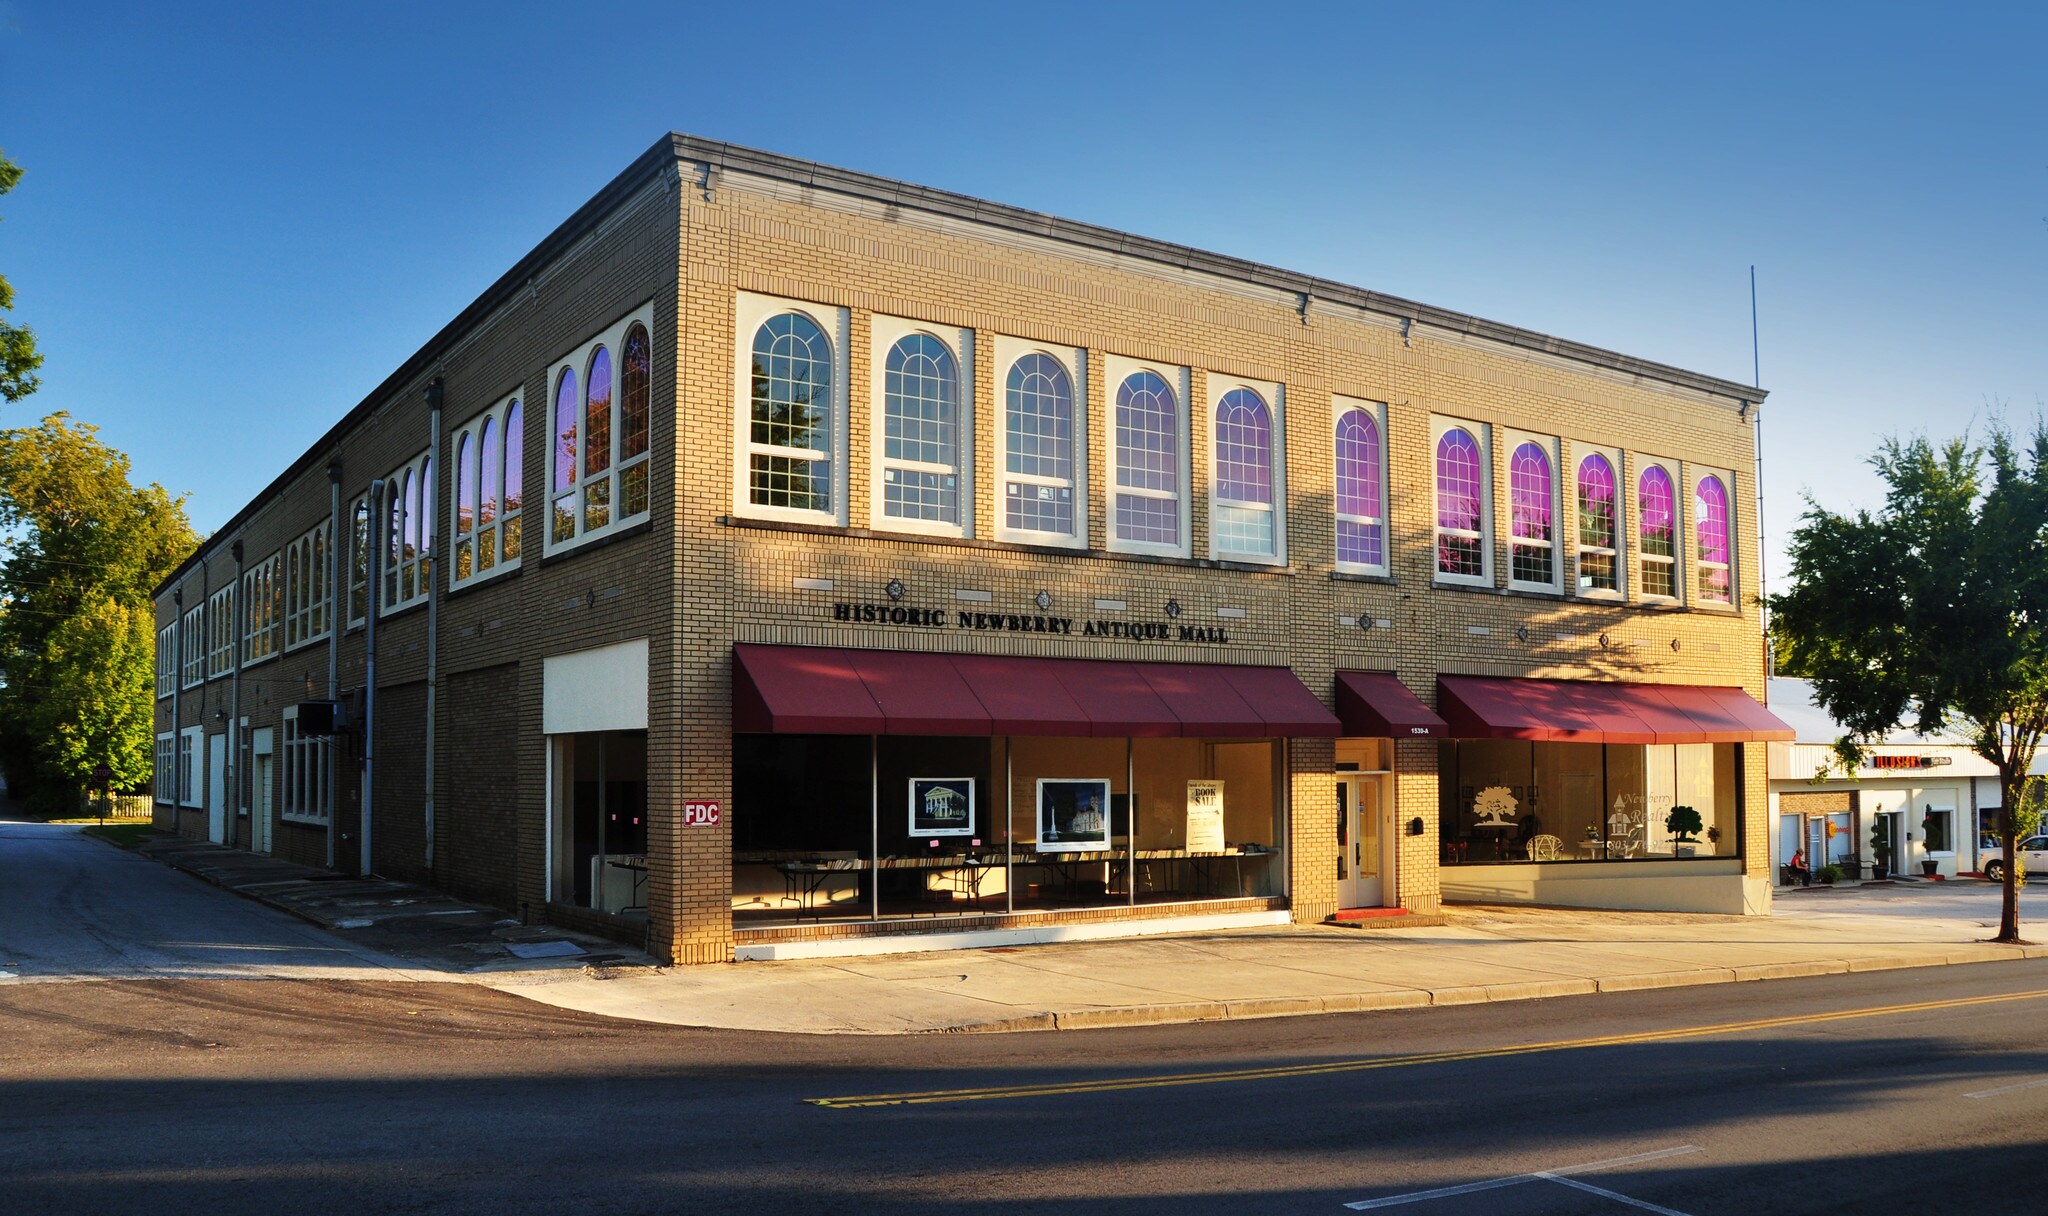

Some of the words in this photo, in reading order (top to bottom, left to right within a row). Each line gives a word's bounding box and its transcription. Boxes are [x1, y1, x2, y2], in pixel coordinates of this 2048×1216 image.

[834, 603, 945, 626] HISTORIC
[958, 611, 1072, 634] NEWBERRY
[1083, 619, 1169, 641] ANTIQUE
[1179, 625, 1228, 643] MALL
[94, 769, 111, 777] STOP
[1195, 788, 1217, 797] BOOK
[1195, 796, 1217, 807] SALE
[685, 804, 718, 823] FDC
